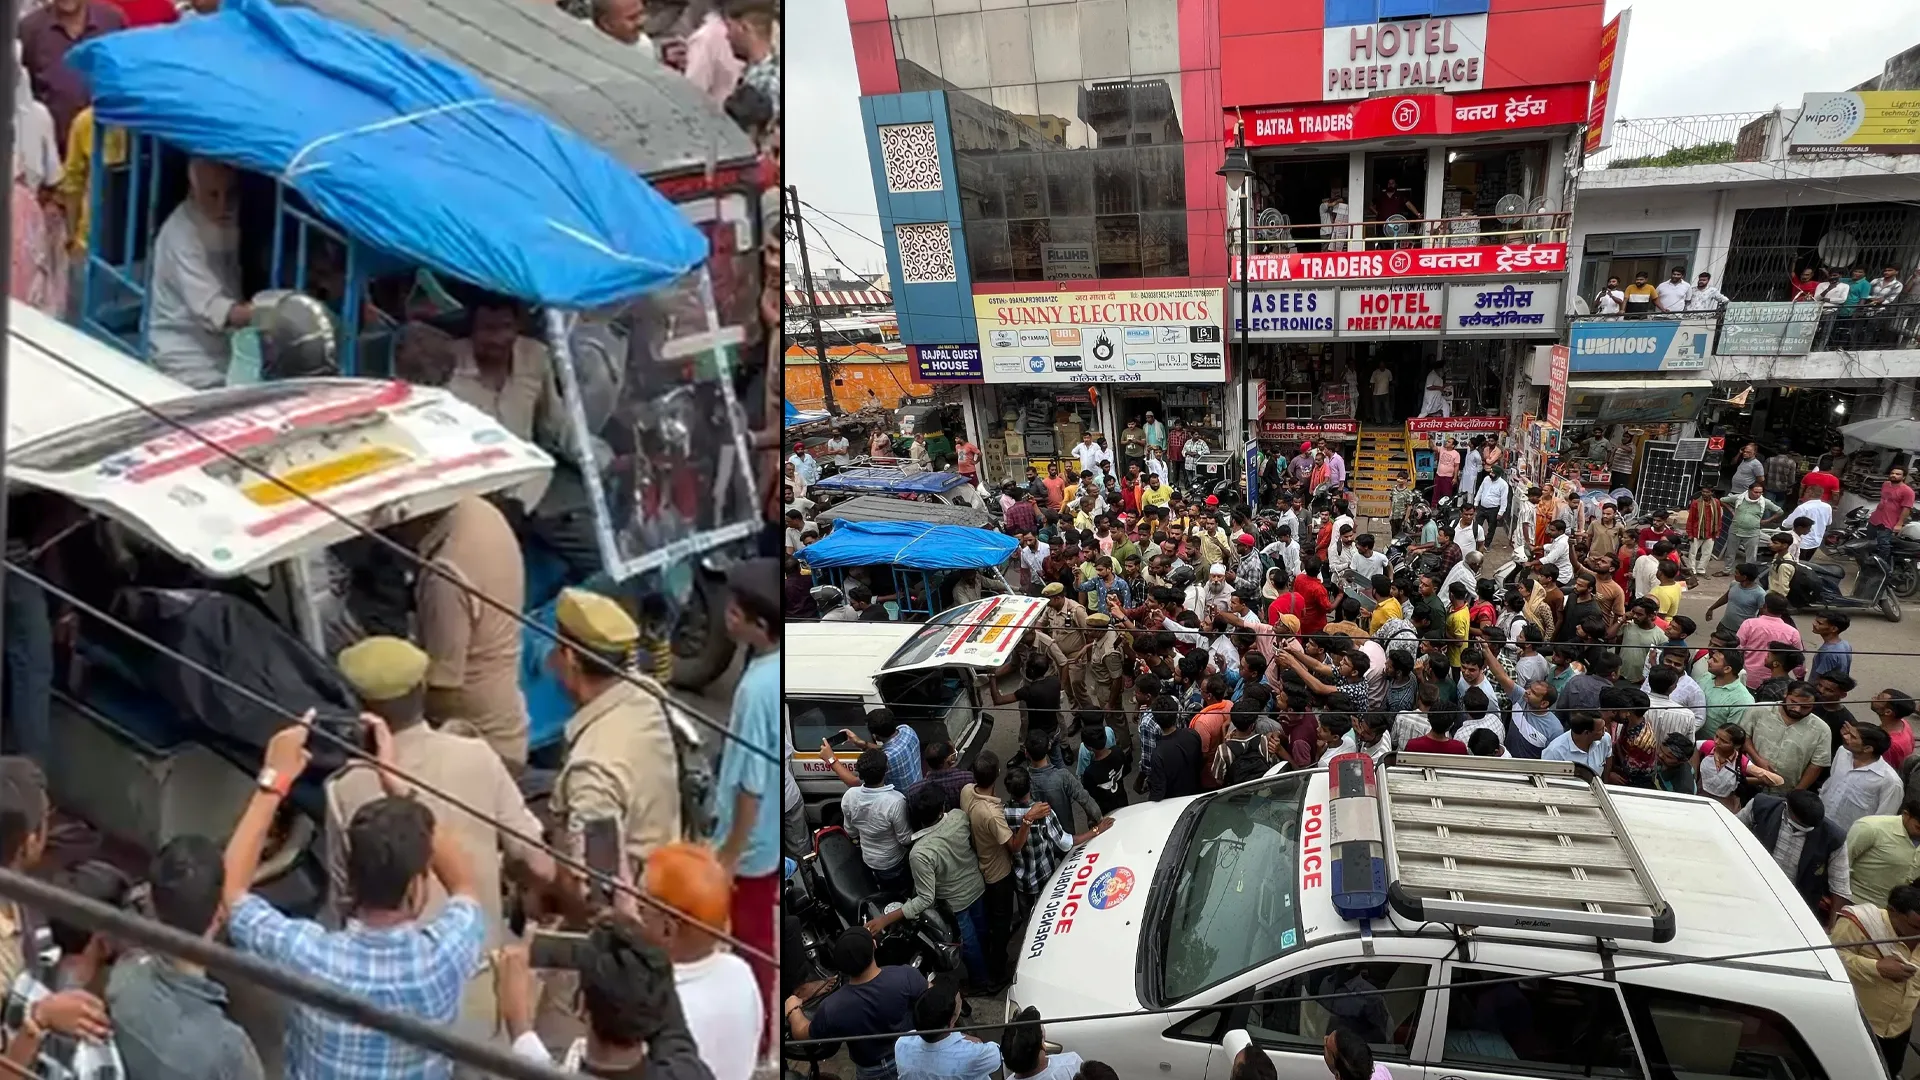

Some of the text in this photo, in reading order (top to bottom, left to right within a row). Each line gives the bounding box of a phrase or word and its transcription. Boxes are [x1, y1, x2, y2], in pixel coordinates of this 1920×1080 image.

[1350, 19, 1458, 61] HOTEL
[1329, 57, 1479, 91] PREET PALACE
[1456, 104, 1498, 121] बतरा
[1805, 114, 1839, 125] wipro
[1881, 110, 1920, 118] technolog
[1256, 112, 1353, 136] BATRA TRADERS
[1301, 255, 1383, 278] TRADERS
[1419, 252, 1482, 269] बतरा
[1252, 293, 1317, 313] ASEES
[1360, 293, 1430, 314] HOTEL
[1474, 285, 1534, 309] असीस
[997, 300, 1208, 326] SUNNY ELECTRONICS
[1236, 317, 1333, 331] EECTRONICS
[1347, 315, 1442, 331] PREET PALACE
[921, 349, 978, 360] RAJPAL GUEST
[1552, 355, 1566, 369] HOTEL
[932, 361, 969, 370] HOUSE
[1551, 368, 1564, 380] PREET
[1550, 380, 1564, 395] PALACE
[1303, 803, 1322, 890] POLICE
[1054, 853, 1100, 935] POLICE
[1515, 919, 1551, 928] Super Action
